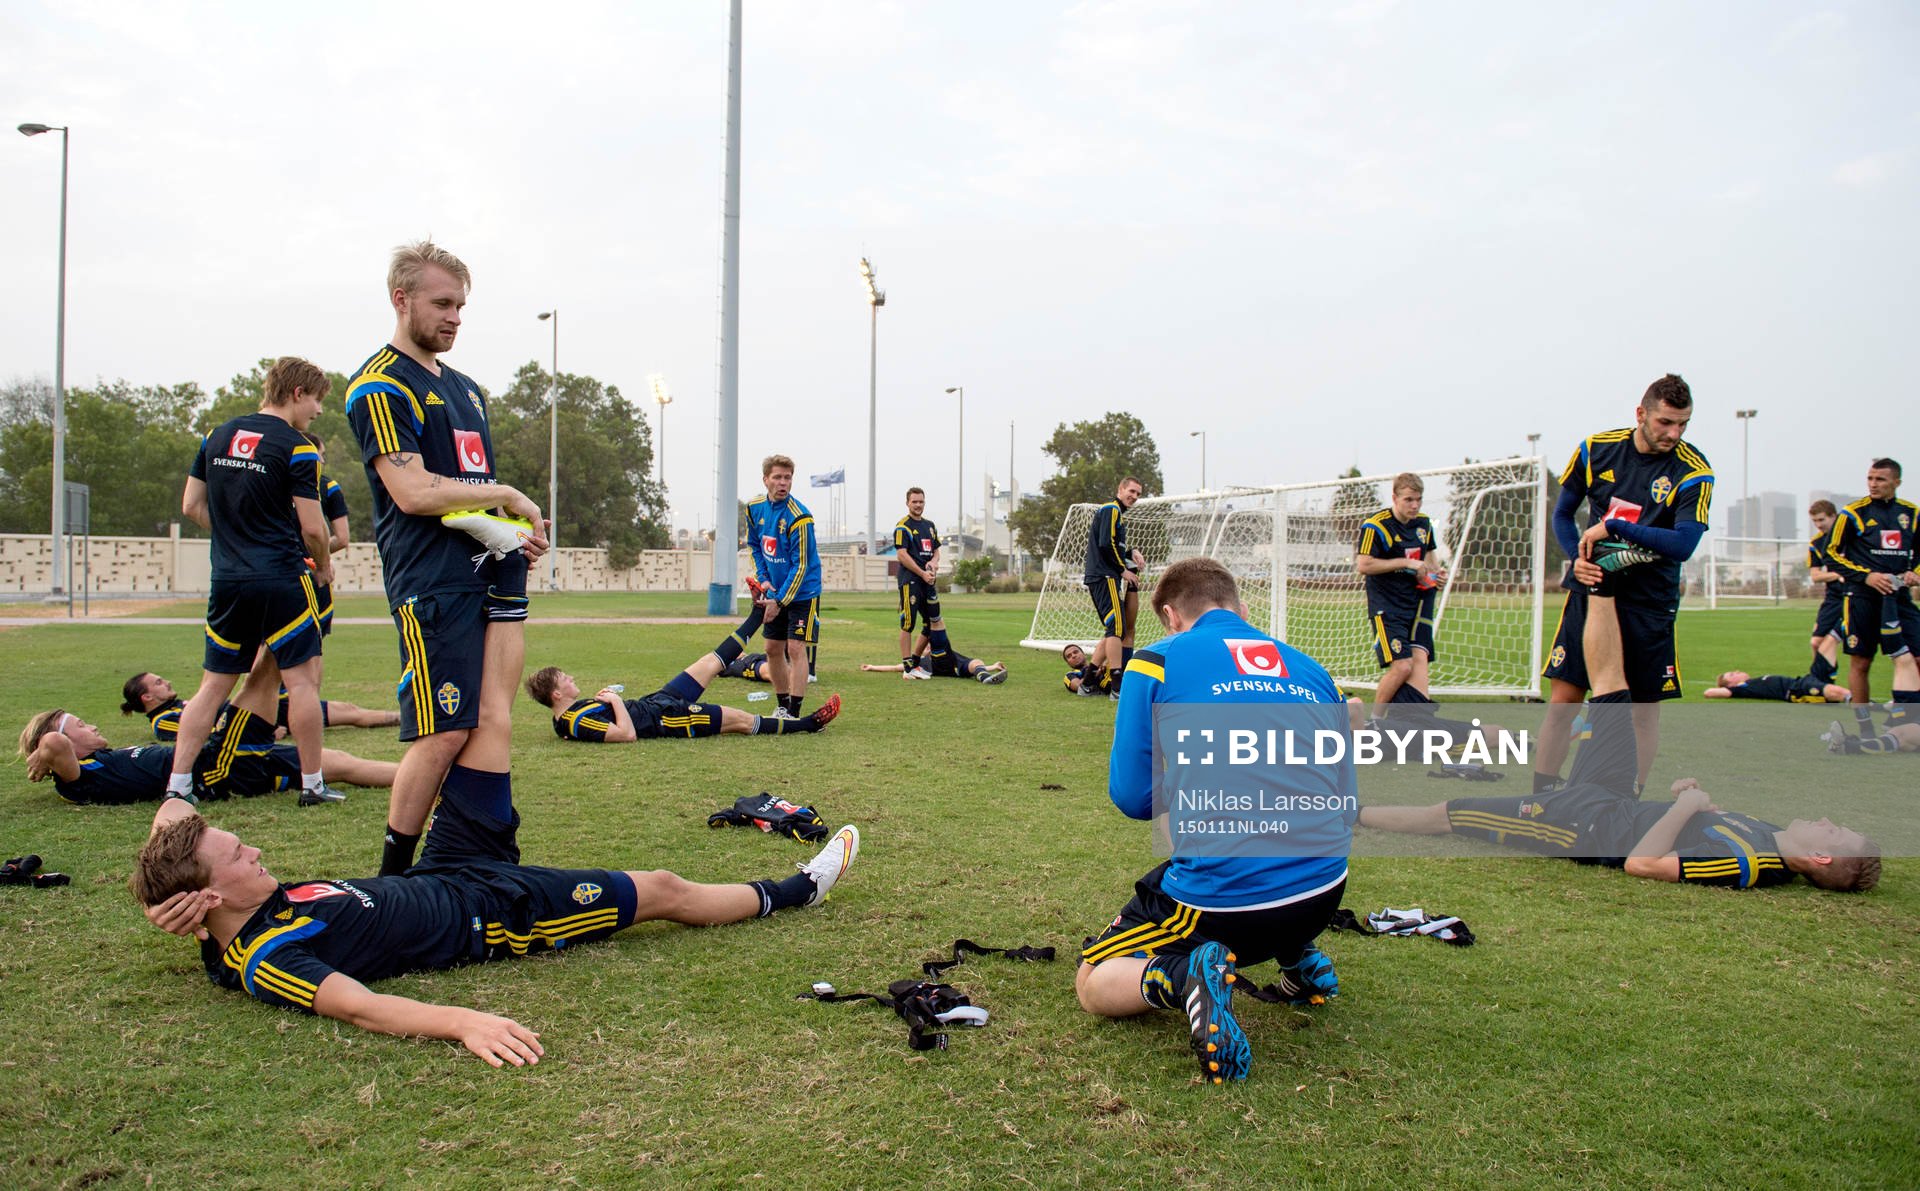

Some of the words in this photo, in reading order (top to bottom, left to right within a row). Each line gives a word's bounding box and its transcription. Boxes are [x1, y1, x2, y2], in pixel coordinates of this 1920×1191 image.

[213, 457, 246, 469] SVENSKA
[247, 461, 267, 473] SPEL
[1211, 680, 1286, 695] SVENSKA
[1288, 684, 1320, 704] SPEL
